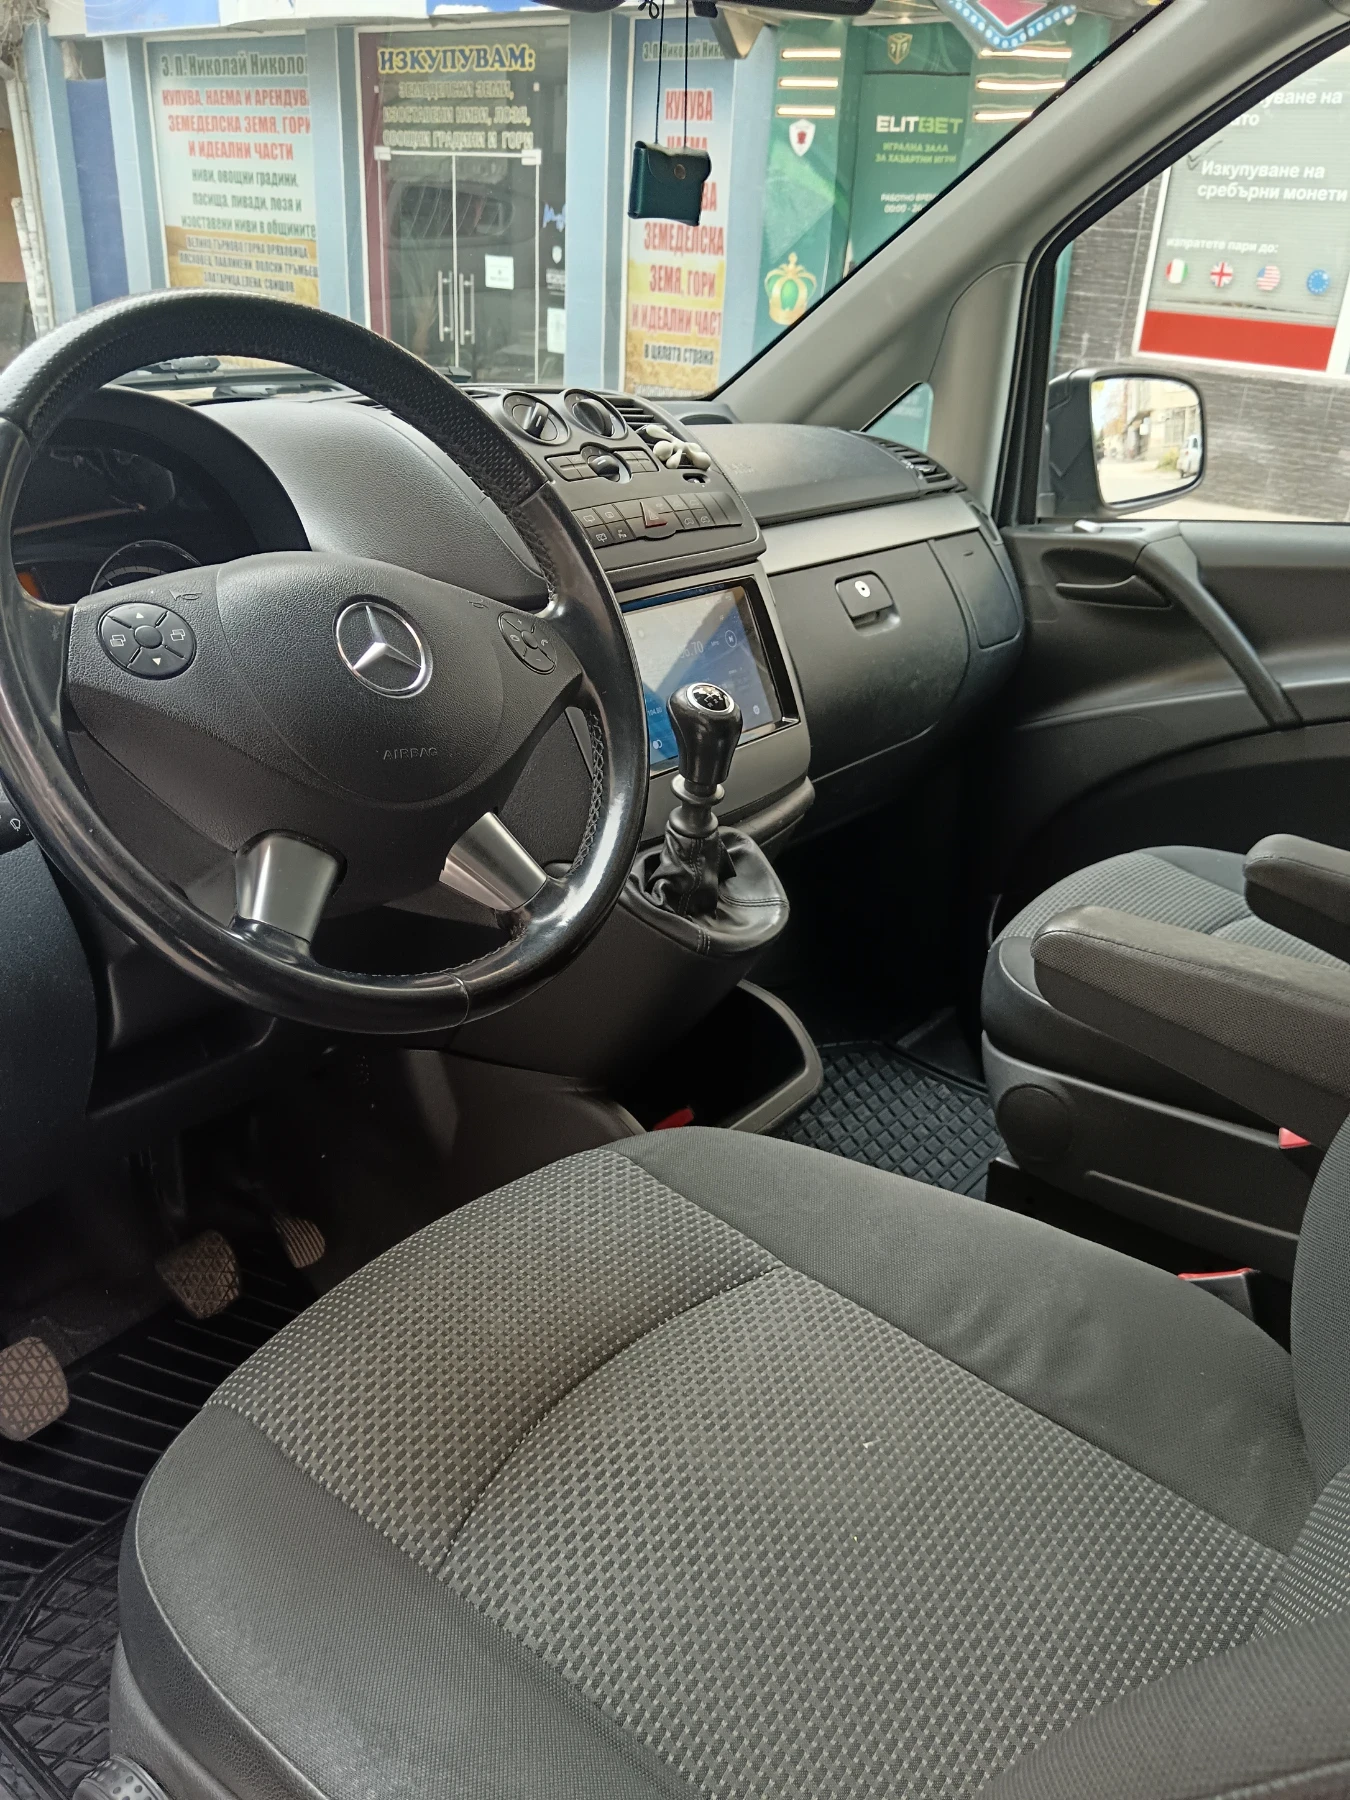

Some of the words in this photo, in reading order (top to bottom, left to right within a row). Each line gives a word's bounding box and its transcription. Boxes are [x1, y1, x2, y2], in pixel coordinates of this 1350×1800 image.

[378, 44, 536, 73] ИЗКУПУВАМ:
[662, 39, 700, 59] Никоай
[188, 53, 248, 76] Николай
[250, 54, 308, 76] Николо
[205, 89, 242, 106] НАЕМА
[244, 89, 251, 106] И
[254, 89, 309, 108] АРЕНДУВ
[665, 89, 713, 121] КУПУВА
[1320, 91, 1343, 105] на
[168, 115, 241, 133] ЗЕМЕДЕЛСКА
[876, 115, 963, 134] ELITBET
[188, 140, 196, 157] И
[198, 140, 251, 159] ИДЕАЛНИ
[254, 142, 294, 160] ЧАСТИ
[1201, 160, 1300, 180] Изкупуване
[1303, 165, 1326, 180] на
[1197, 182, 1280, 202] сребърни
[1283, 187, 1348, 202] монети
[296, 199, 302, 212] и
[267, 218, 317, 239] общините
[644, 222, 724, 257] ЗЕМЕДЕЛСКА
[1166, 237, 1225, 250] изпратете
[1227, 241, 1257, 253] пари
[1258, 243, 1279, 254] до:
[688, 270, 716, 297] ГОРИ
[631, 304, 639, 328] И
[641, 306, 692, 334] ИДЕАЛНИ
[695, 311, 721, 337] ЧАСТ
[383, 747, 438, 760] AIRBAG
